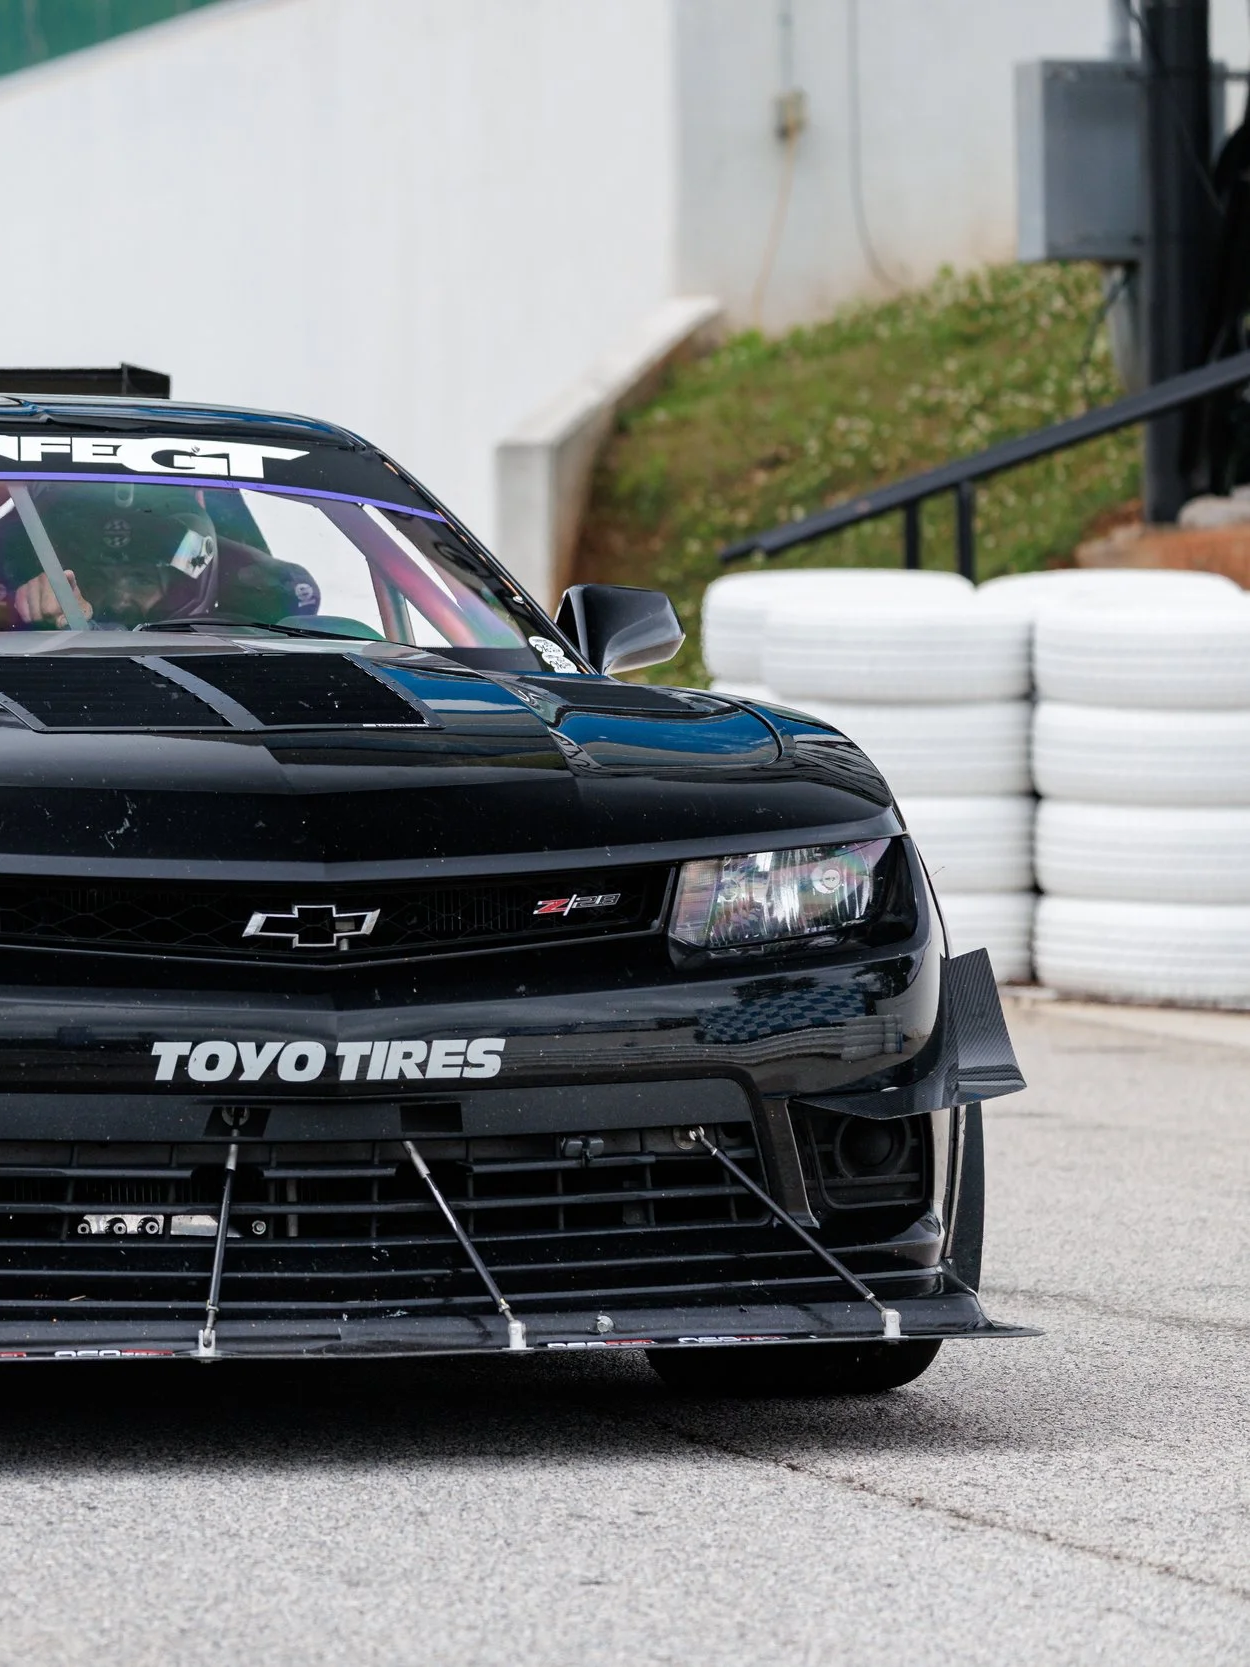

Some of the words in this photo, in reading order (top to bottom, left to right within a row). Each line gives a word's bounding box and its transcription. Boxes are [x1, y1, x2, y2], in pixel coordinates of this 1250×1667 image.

[116, 437, 310, 479] GT
[151, 1040, 327, 1082] TOYO
[335, 1038, 506, 1081] TIRES
